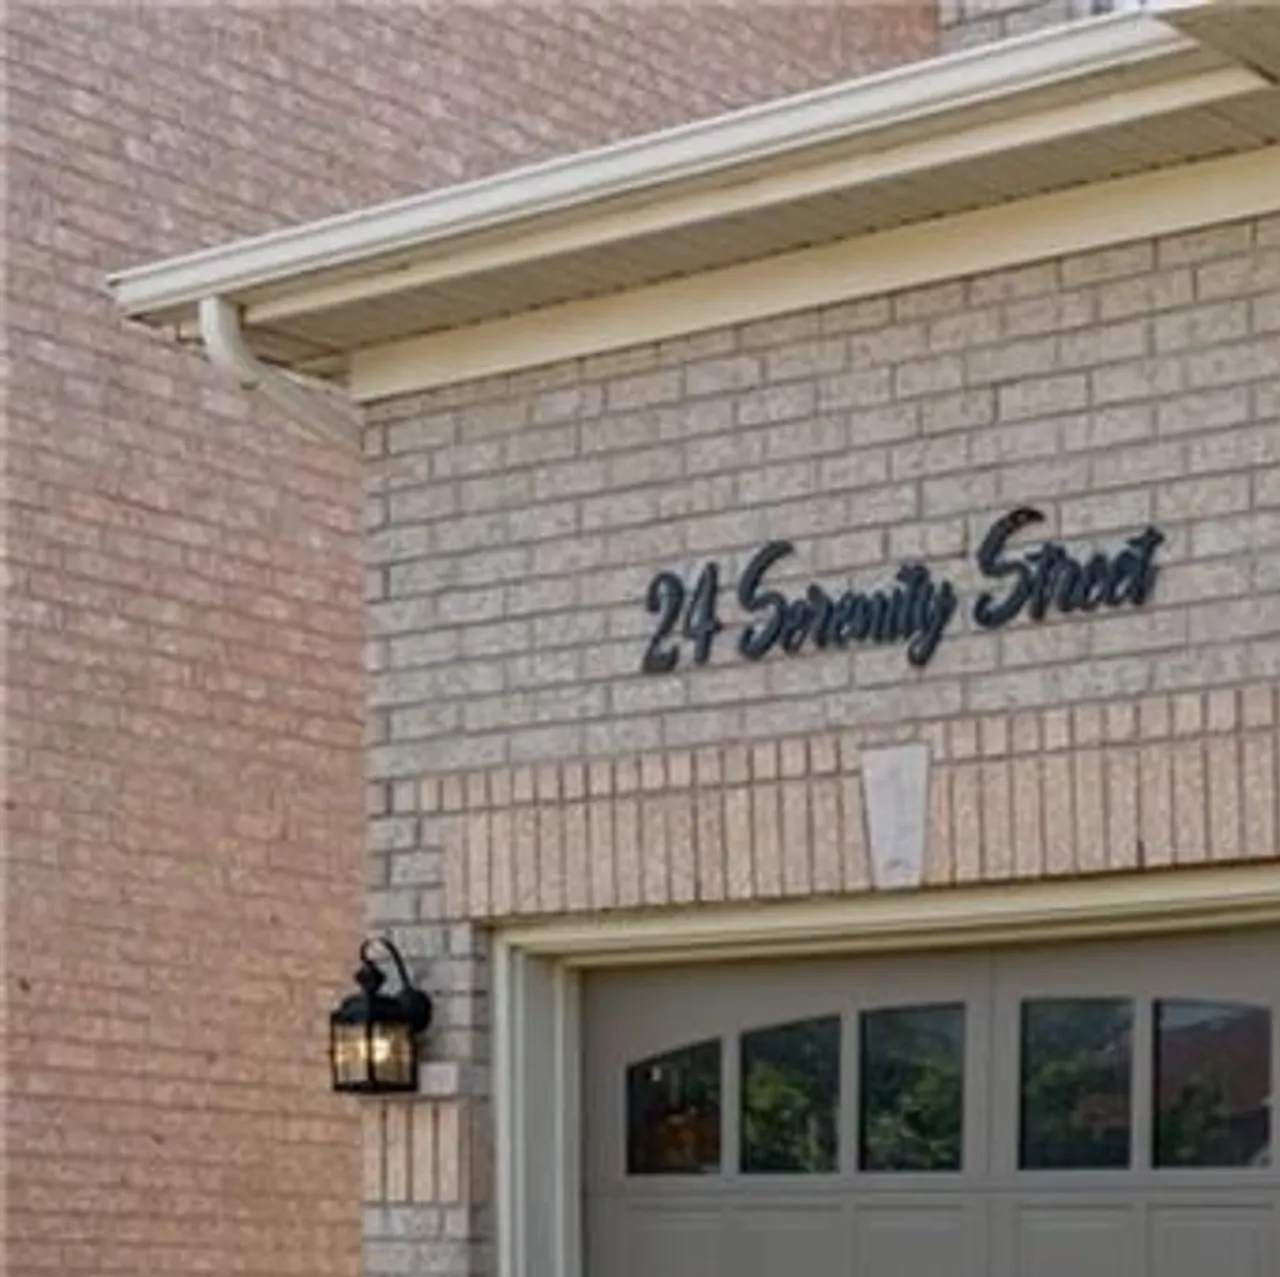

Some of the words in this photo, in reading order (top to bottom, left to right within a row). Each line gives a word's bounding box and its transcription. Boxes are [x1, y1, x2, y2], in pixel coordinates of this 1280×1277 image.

[643, 561, 722, 673] 24
[738, 541, 957, 667] Serenity
[974, 507, 1165, 627] Street
